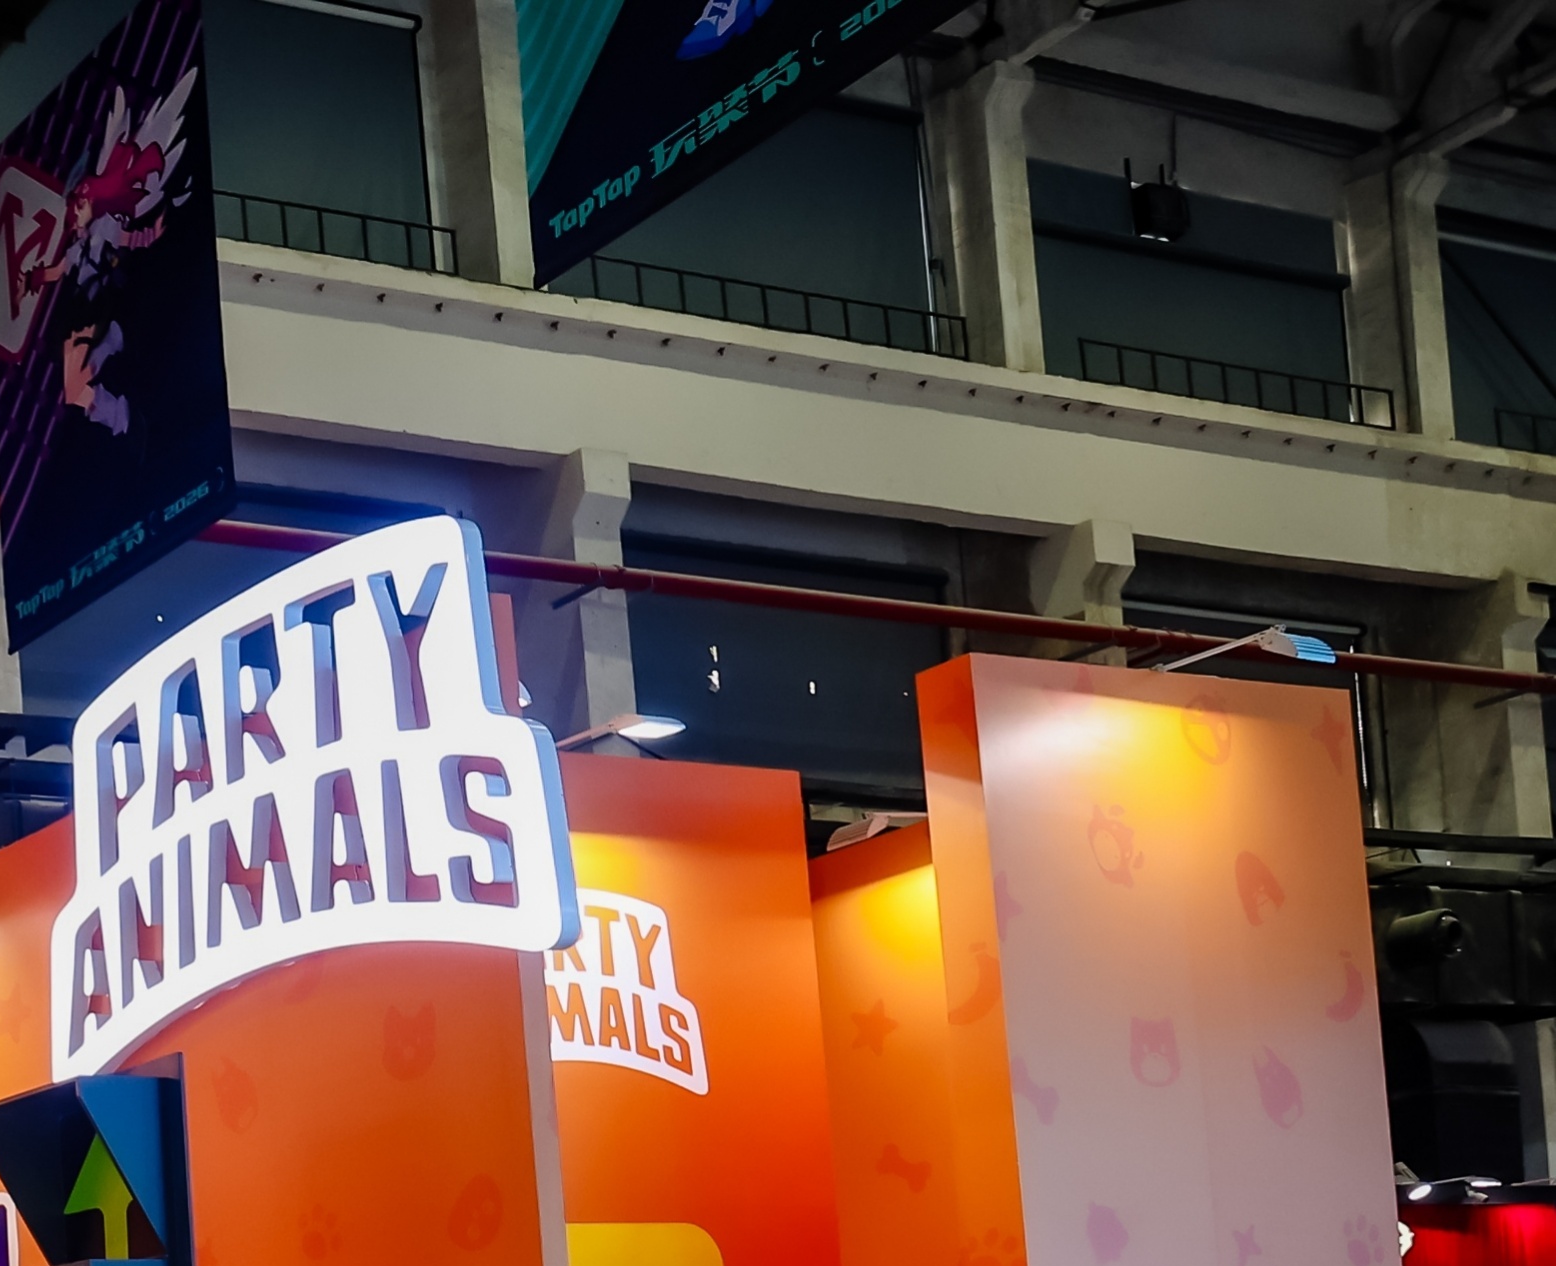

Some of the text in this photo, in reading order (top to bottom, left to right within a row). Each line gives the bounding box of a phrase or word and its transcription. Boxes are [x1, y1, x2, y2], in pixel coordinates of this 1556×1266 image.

[548, 165, 641, 238] TapTap
[15, 578, 65, 620] TapTap
[96, 561, 448, 877] PARTY
[68, 754, 520, 1058] ANIMALS
